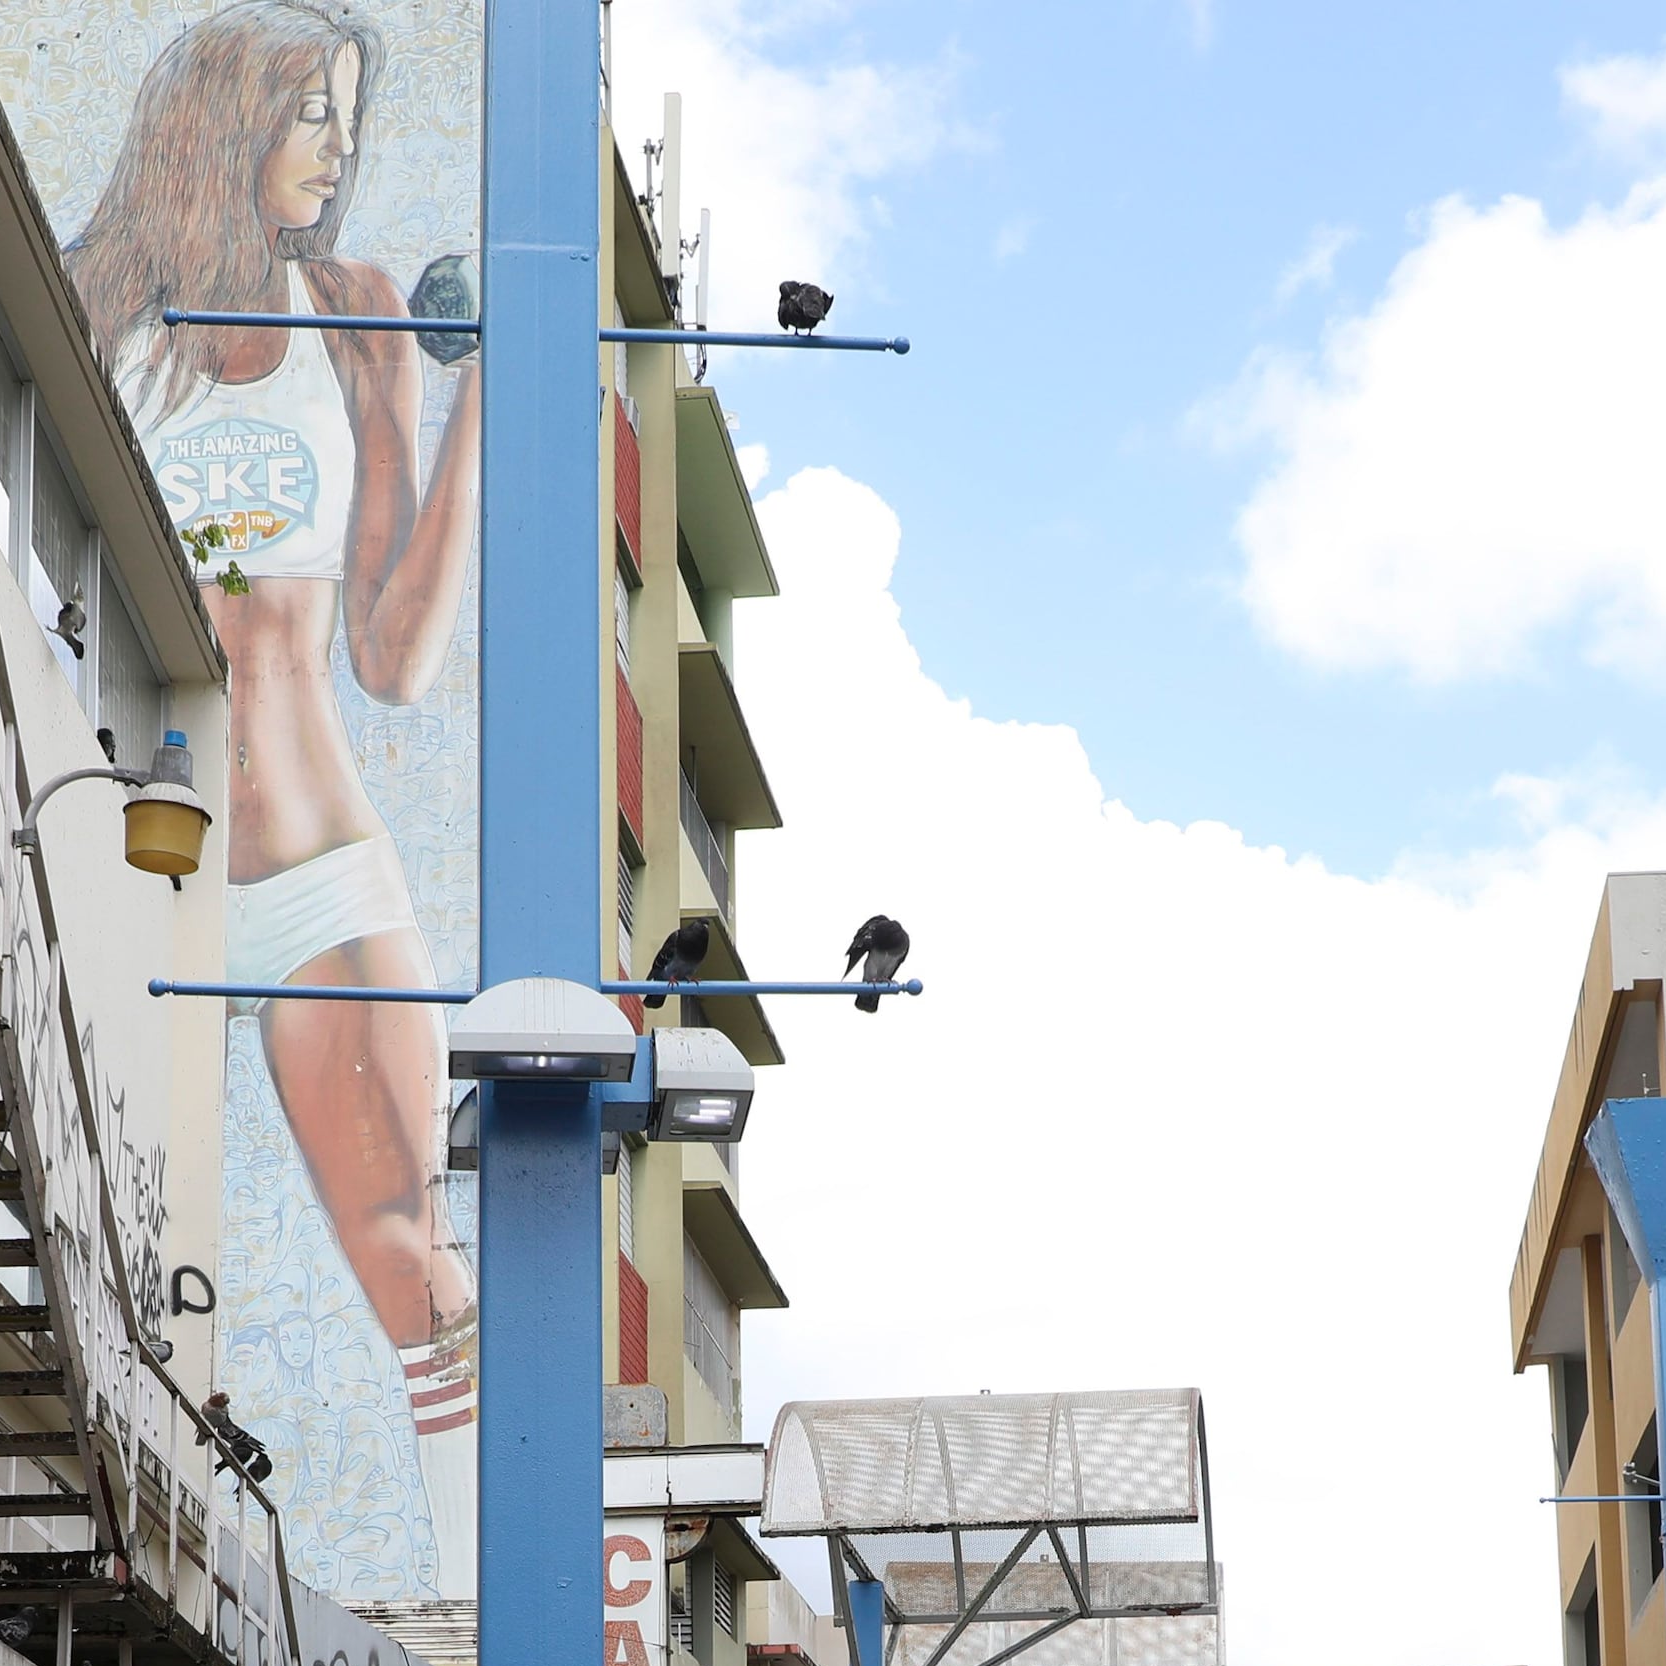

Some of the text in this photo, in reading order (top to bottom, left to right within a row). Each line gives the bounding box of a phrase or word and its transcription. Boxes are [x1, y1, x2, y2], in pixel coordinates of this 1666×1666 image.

[166, 432, 297, 459] THE AMAZING
[157, 457, 305, 524] SKE
[251, 515, 273, 528] TNB
